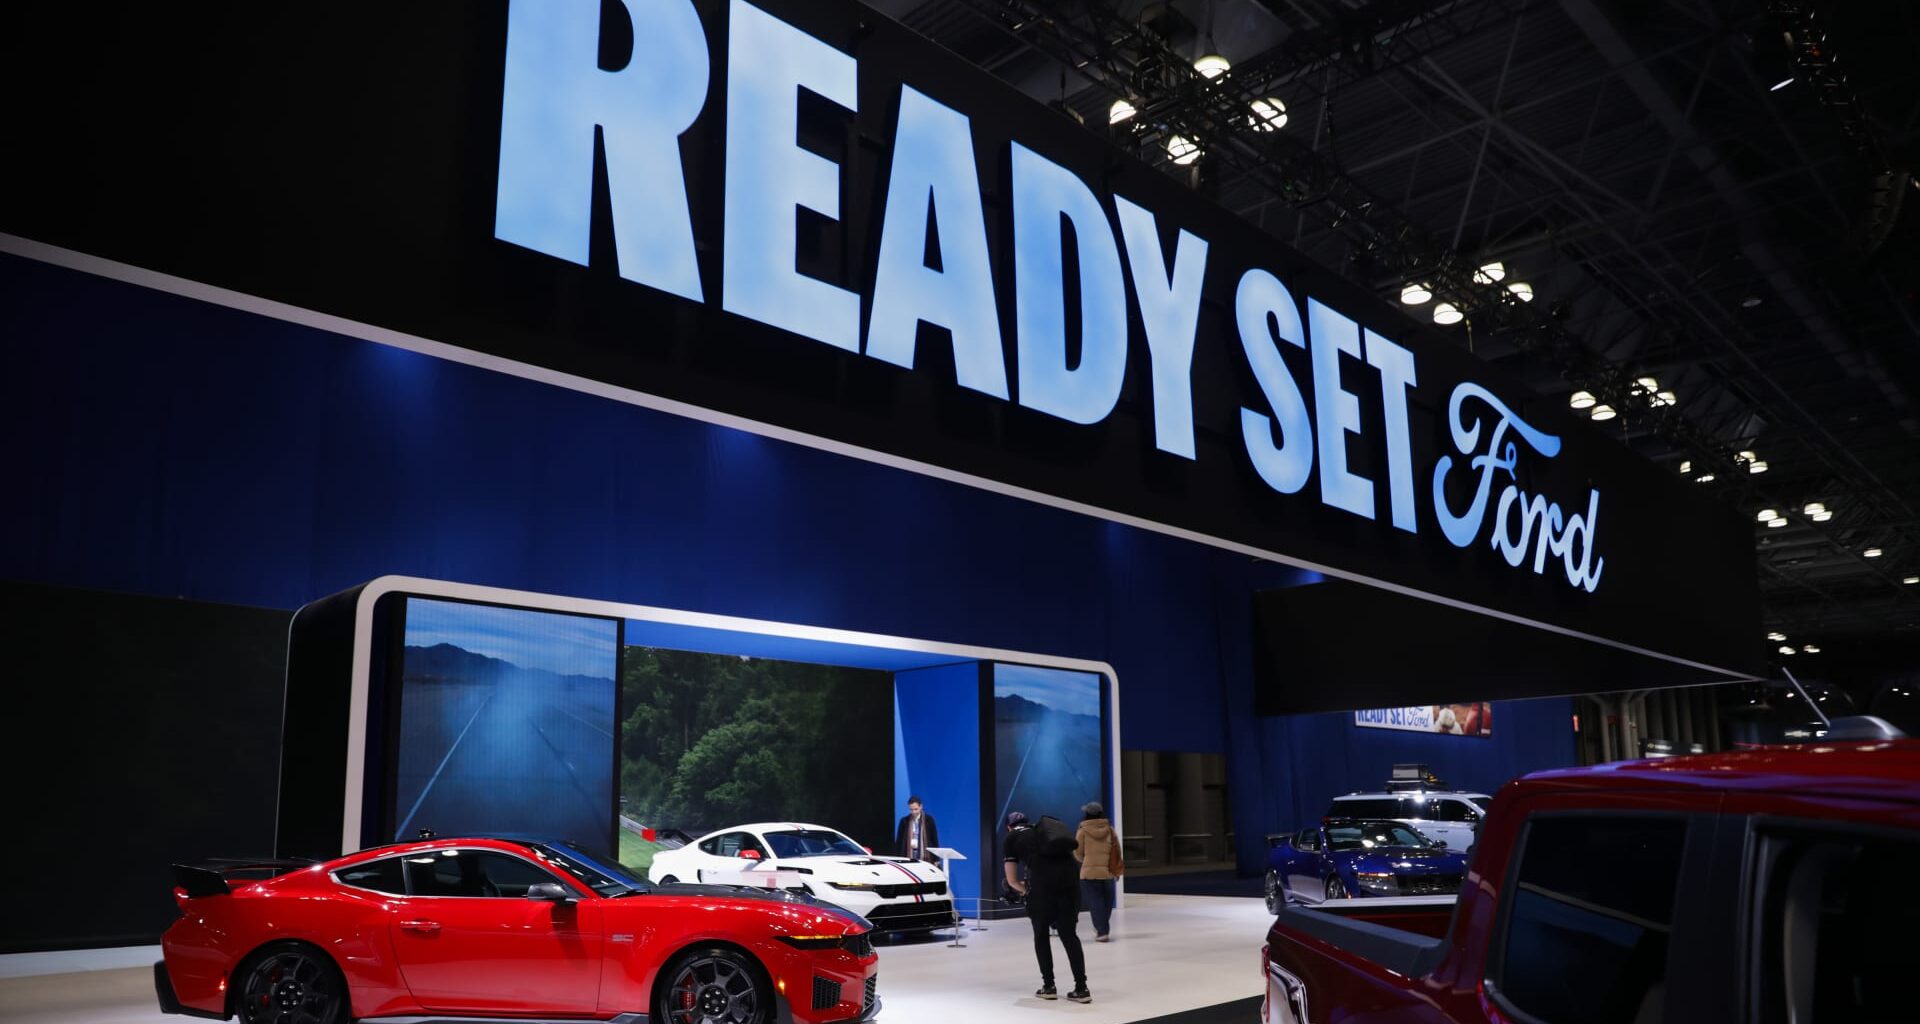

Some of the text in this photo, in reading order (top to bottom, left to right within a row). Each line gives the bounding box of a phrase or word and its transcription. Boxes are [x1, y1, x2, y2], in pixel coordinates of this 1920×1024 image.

[494, 0, 1604, 593] READY SET Ford
[1406, 706, 1430, 728] Ford
